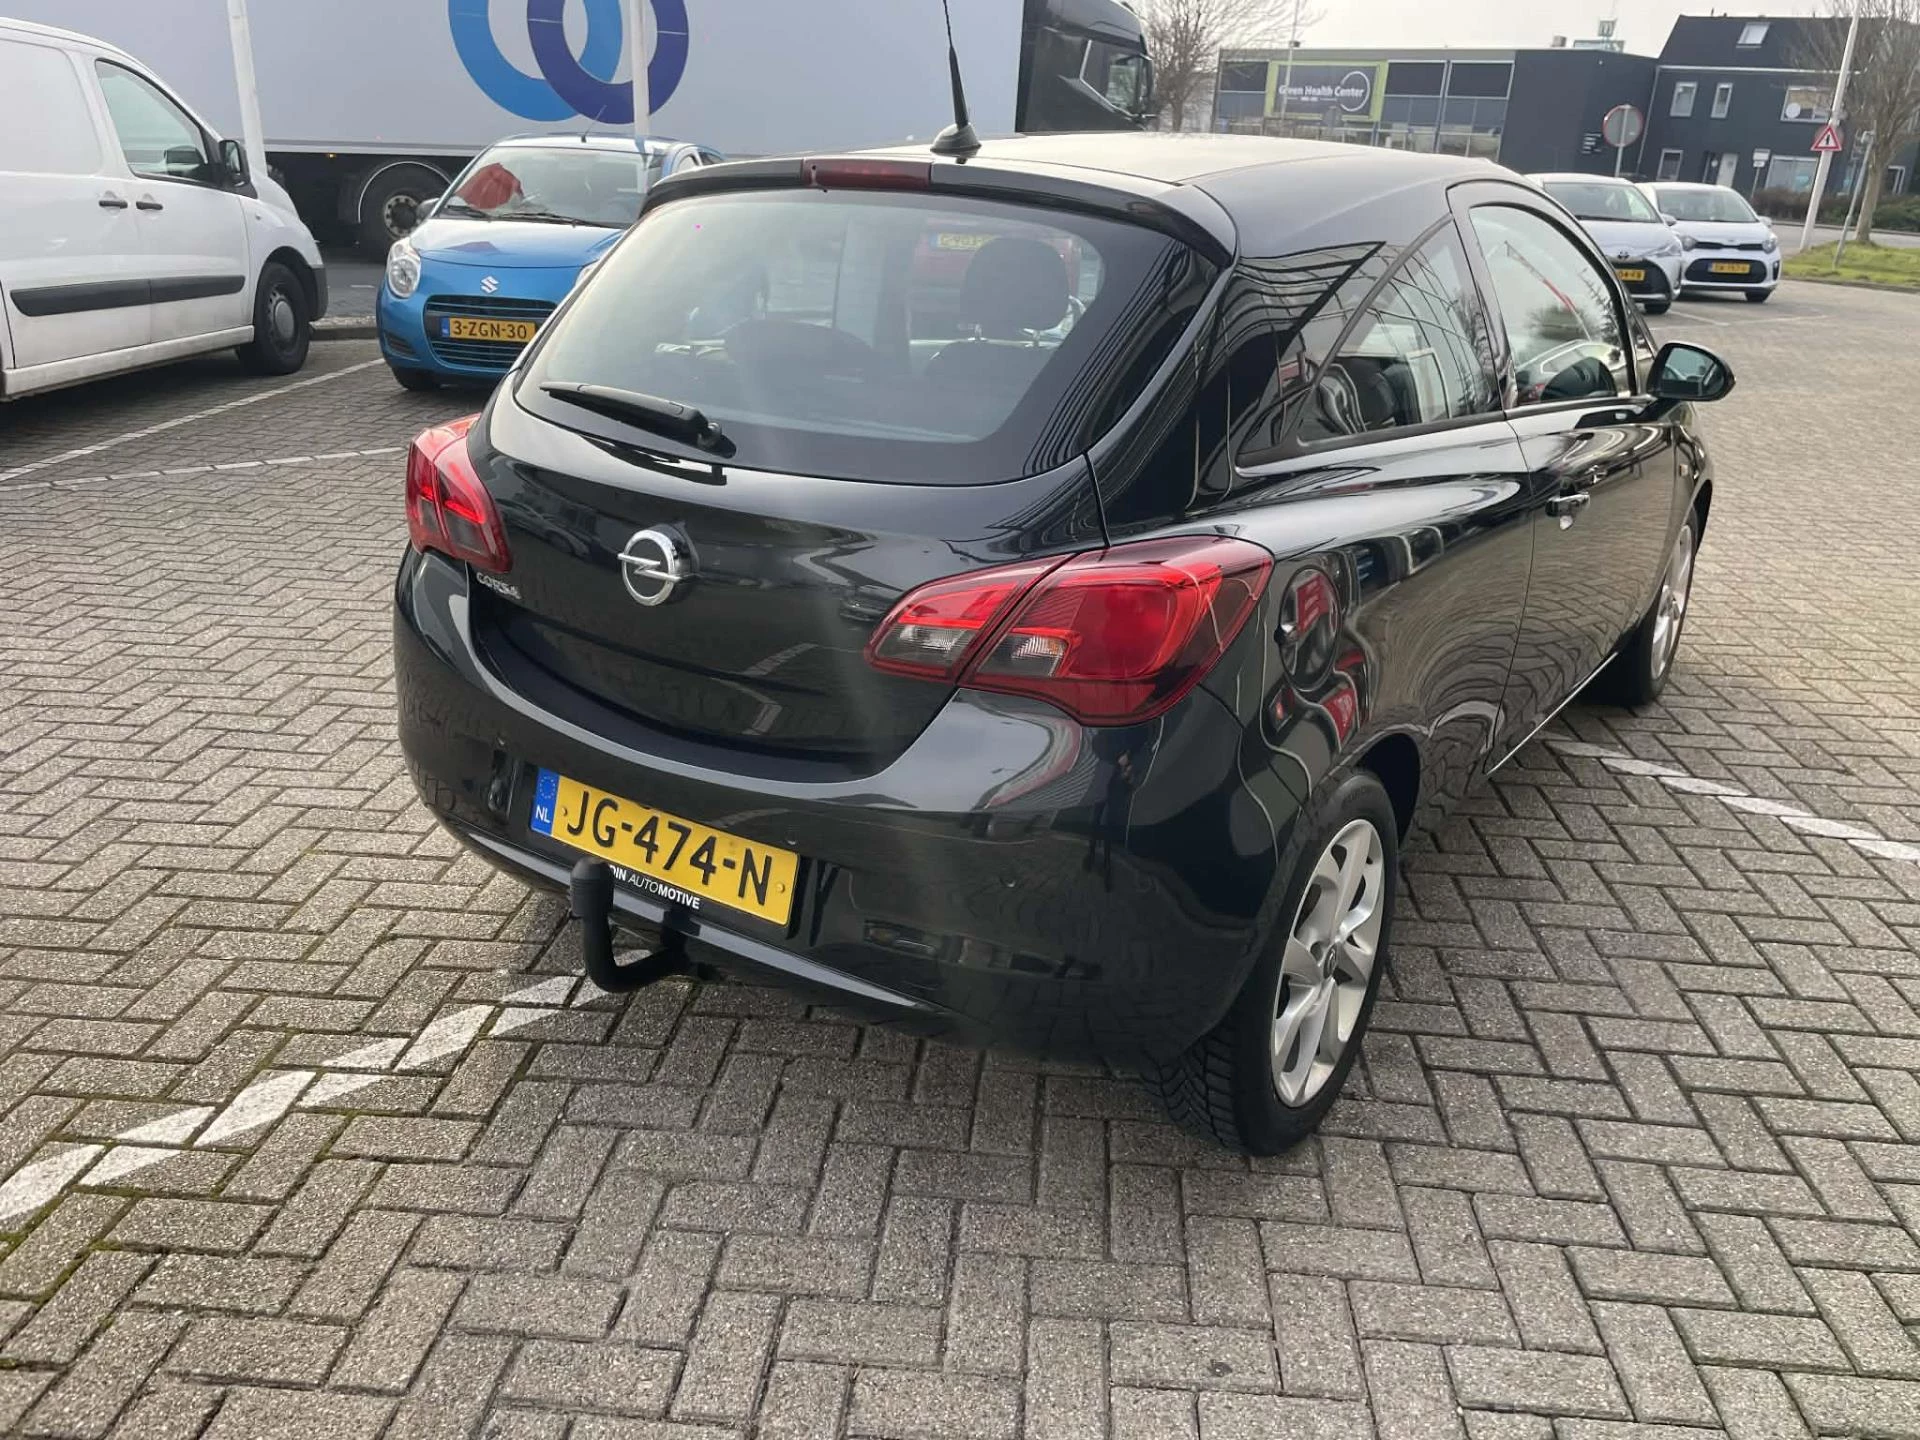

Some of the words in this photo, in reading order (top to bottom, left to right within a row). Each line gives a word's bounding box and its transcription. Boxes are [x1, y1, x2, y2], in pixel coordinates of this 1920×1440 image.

[1304, 86, 1333, 96] Health
[1334, 86, 1364, 97] Center
[453, 320, 527, 339] 3-ZGN-30
[476, 572, 521, 599] CORSA
[535, 805, 550, 823] NL
[566, 791, 773, 906] JG-474-N
[628, 873, 700, 910] AUTOMOTIVE
